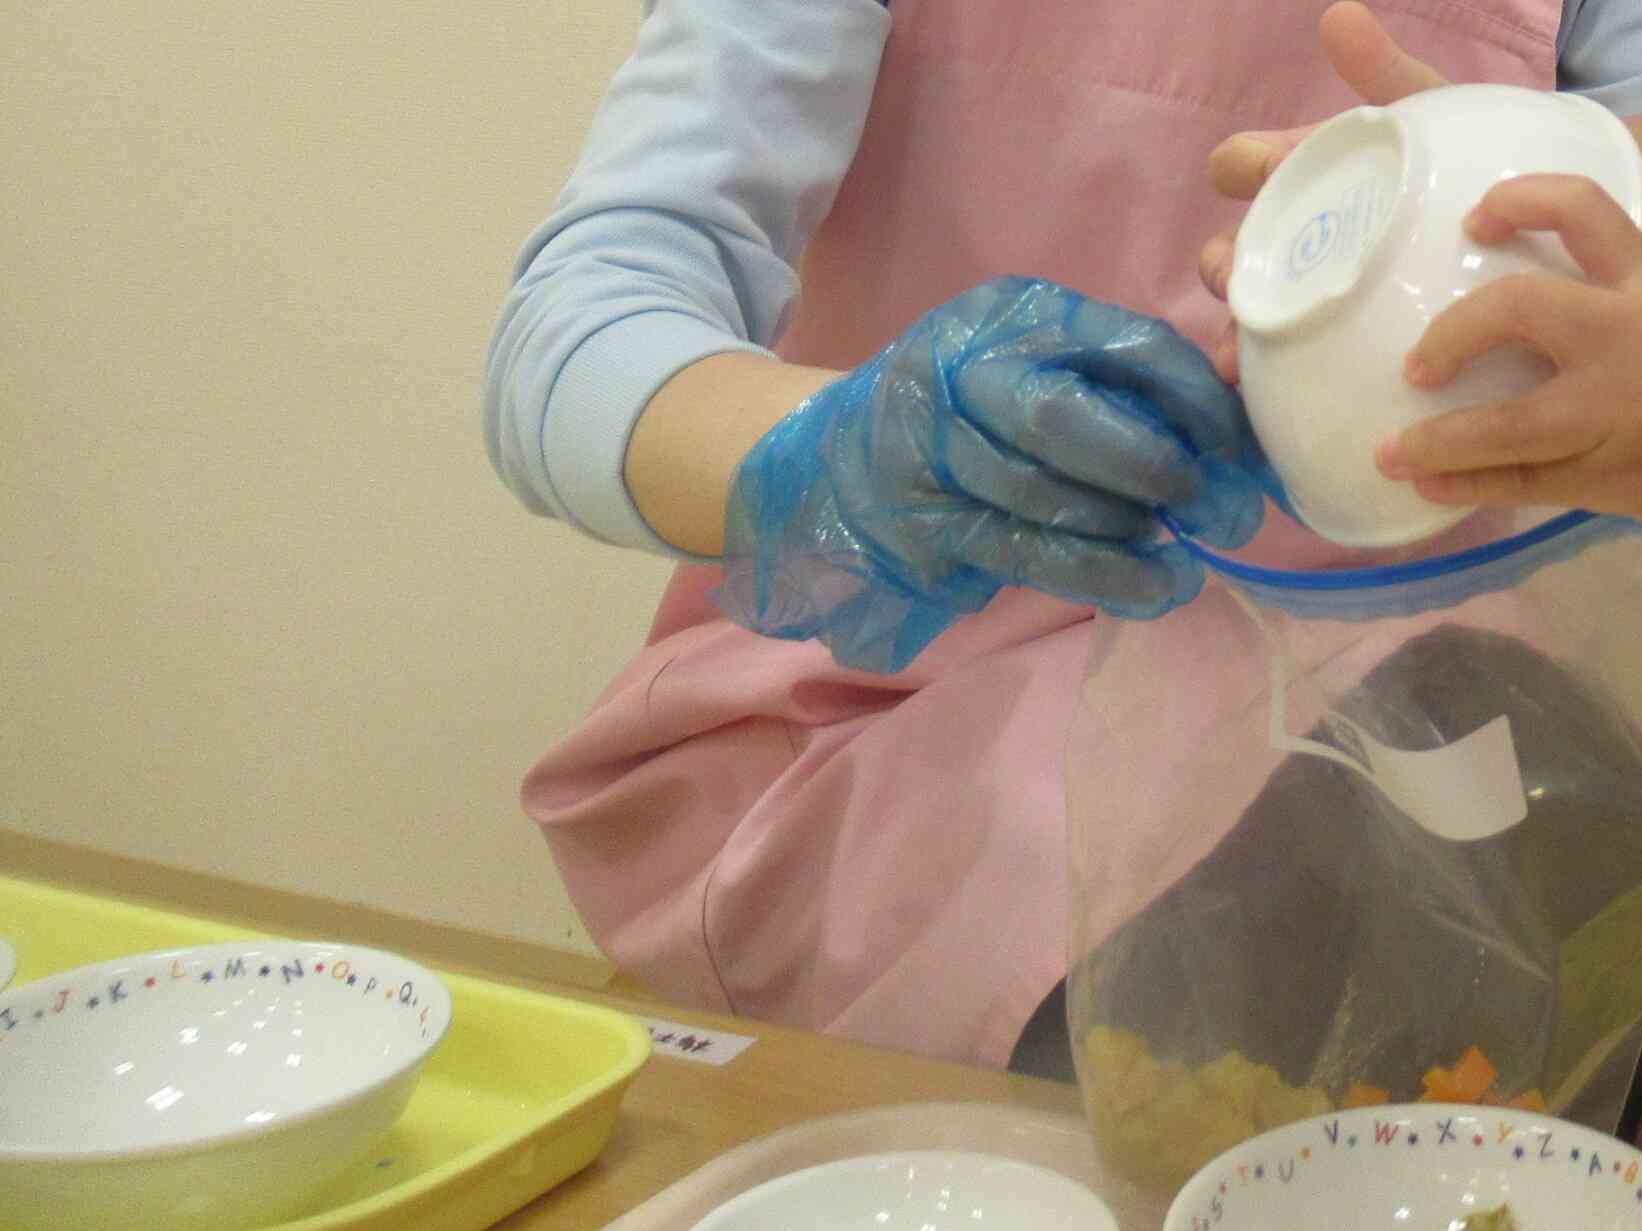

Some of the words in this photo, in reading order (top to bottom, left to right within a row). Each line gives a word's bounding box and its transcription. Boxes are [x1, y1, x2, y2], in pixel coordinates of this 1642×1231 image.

[108, 979, 129, 1004] K
[223, 957, 245, 979] M
[281, 960, 304, 984] N
[1324, 1119, 1339, 1144] V
[1375, 1121, 1398, 1145] W
[1437, 1118, 1457, 1145] X
